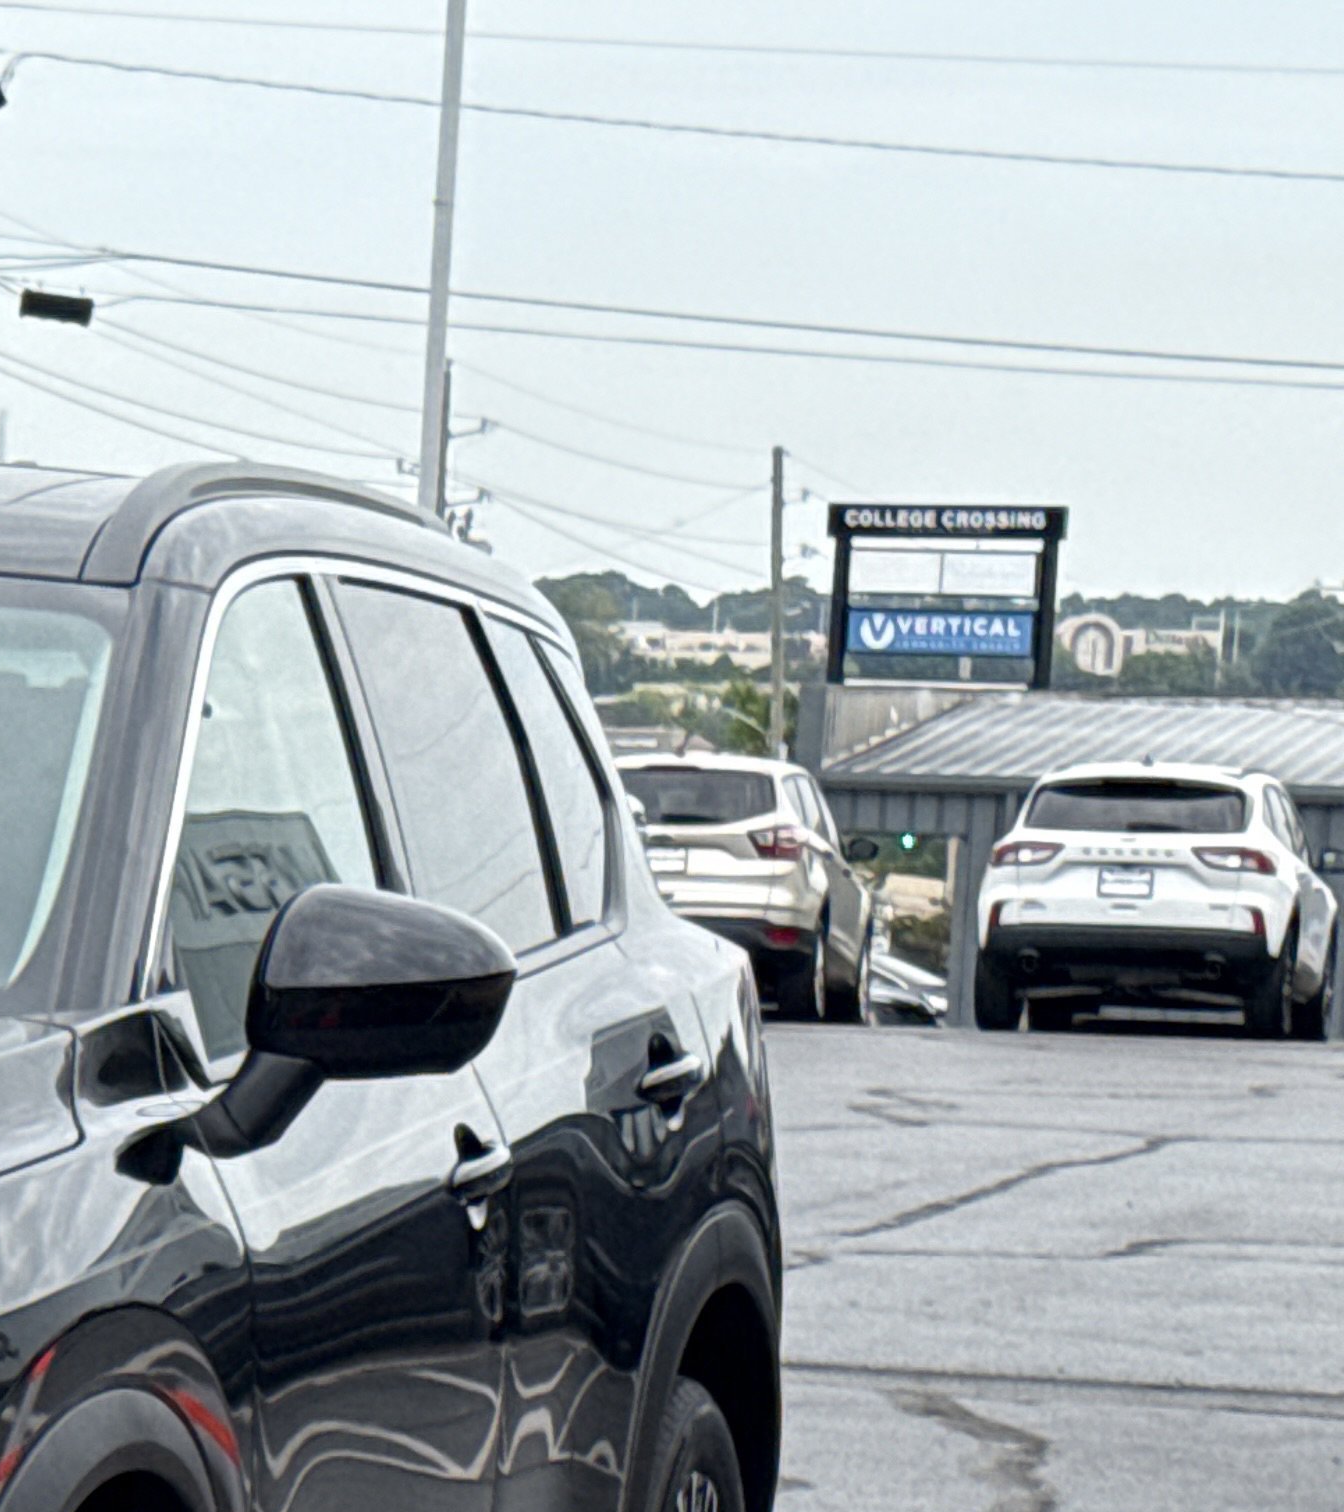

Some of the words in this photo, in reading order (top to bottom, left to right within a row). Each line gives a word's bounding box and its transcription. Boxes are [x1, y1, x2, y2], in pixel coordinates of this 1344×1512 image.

[844, 508, 937, 529] COLLEGE
[941, 509, 1047, 530] CROSSING
[896, 615, 1022, 638] VERTICAL
